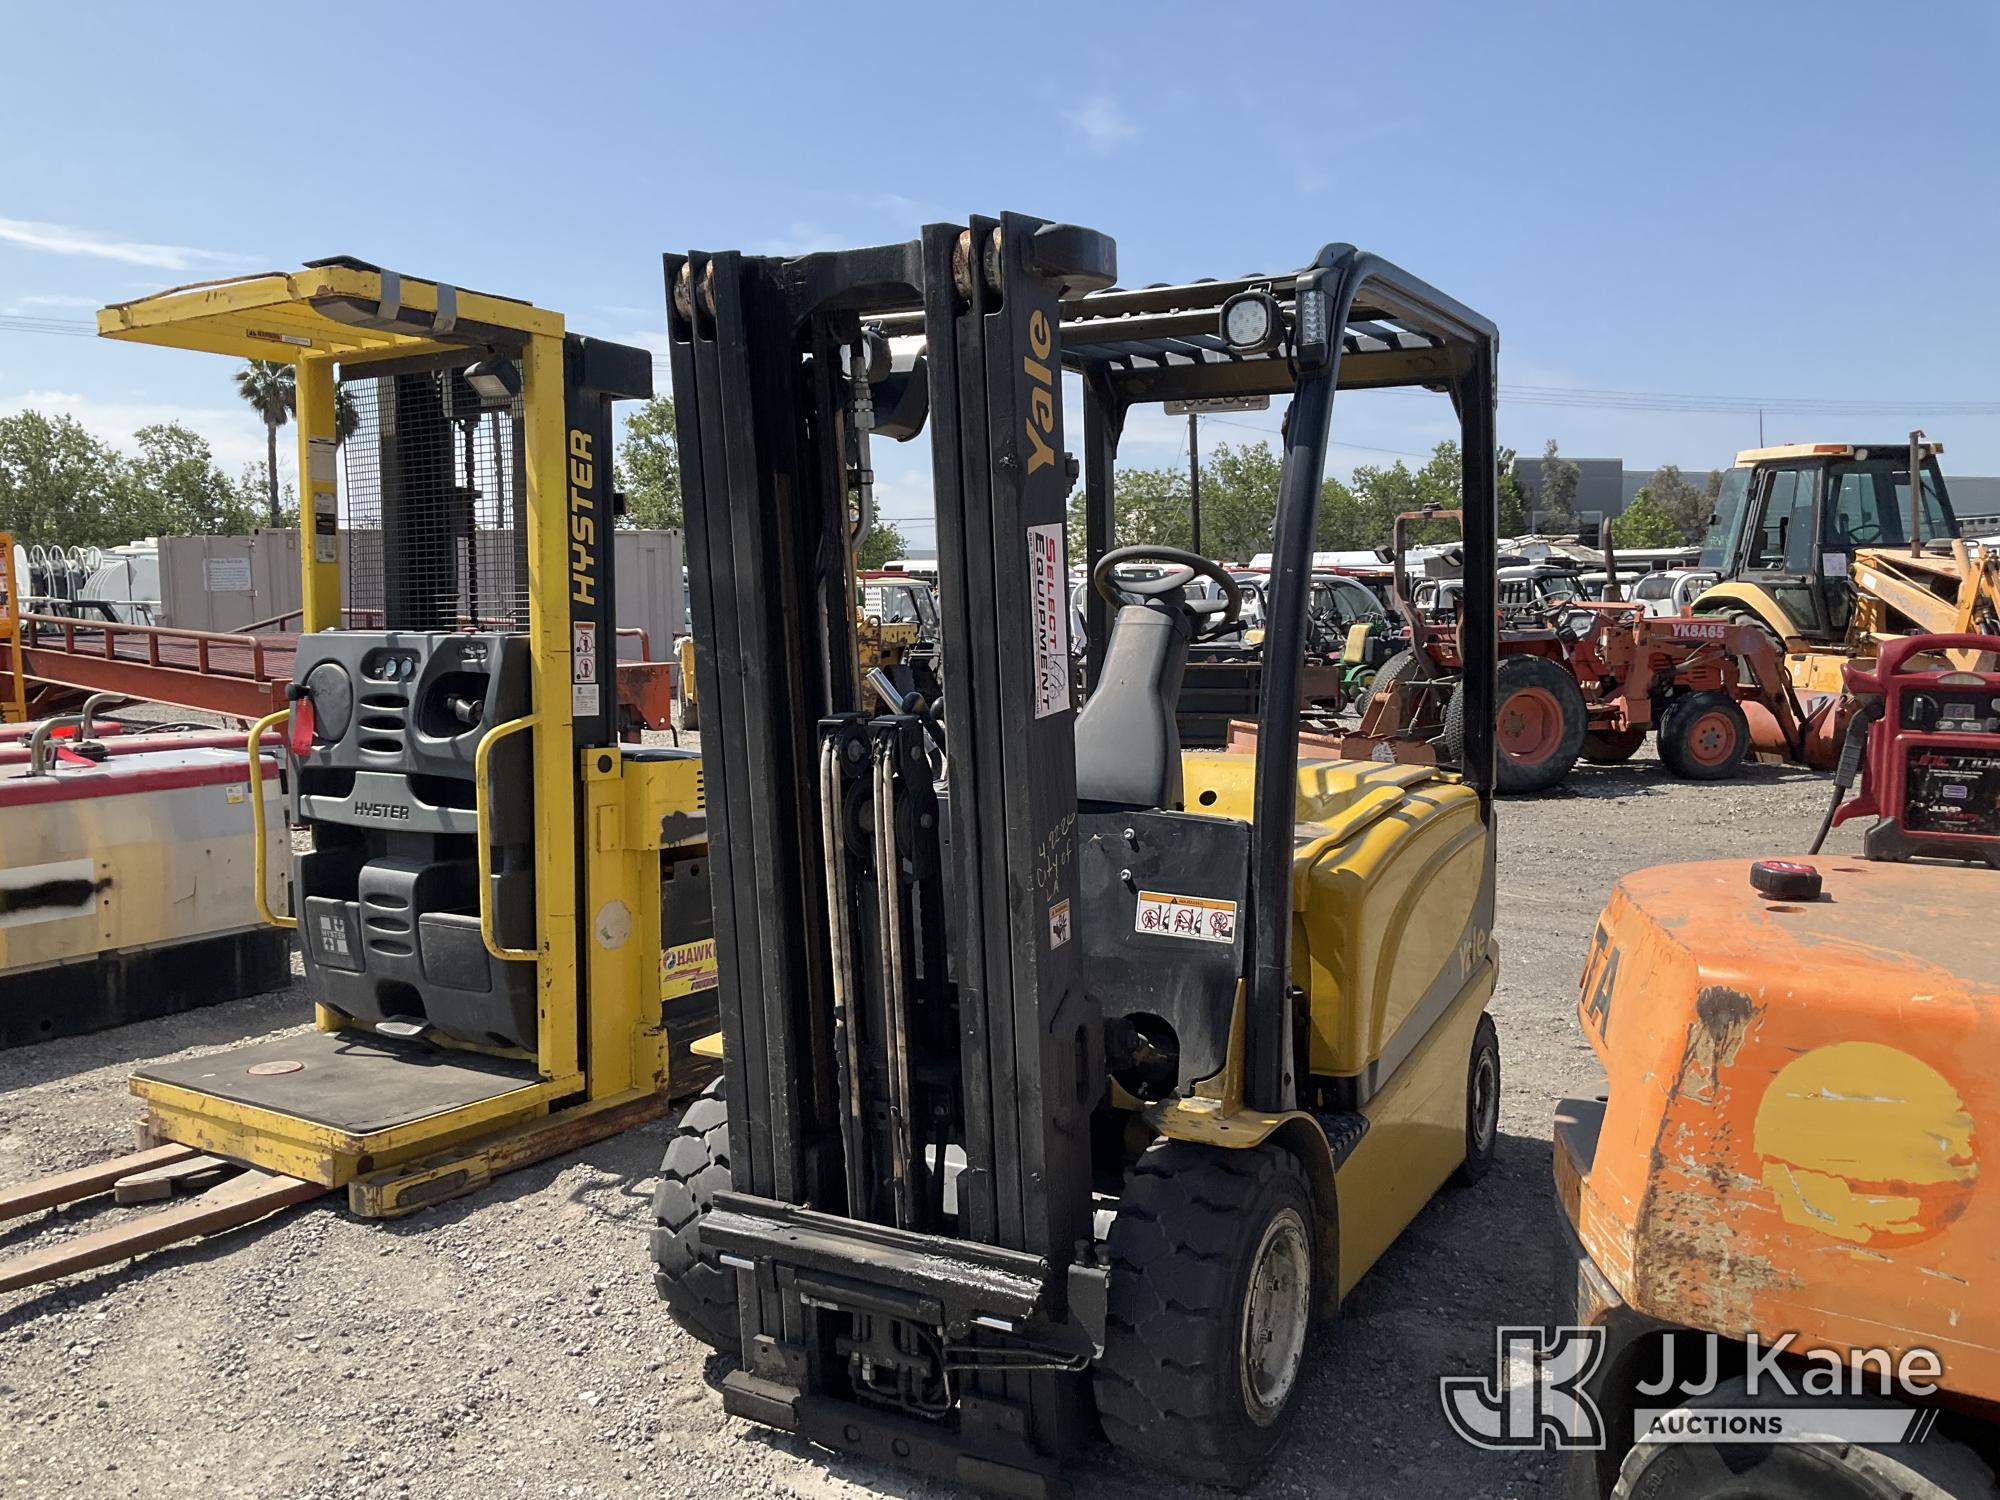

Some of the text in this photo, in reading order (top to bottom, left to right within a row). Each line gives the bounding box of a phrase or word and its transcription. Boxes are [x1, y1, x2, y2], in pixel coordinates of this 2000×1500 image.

[1024, 309, 1055, 475] Yale
[570, 429, 595, 606] HYSTER
[1034, 531, 1051, 710] EQUIPMENT
[1045, 535, 1057, 649] SELECT
[1672, 623, 1725, 639] YK8A65
[354, 801, 409, 819] HYSTER
